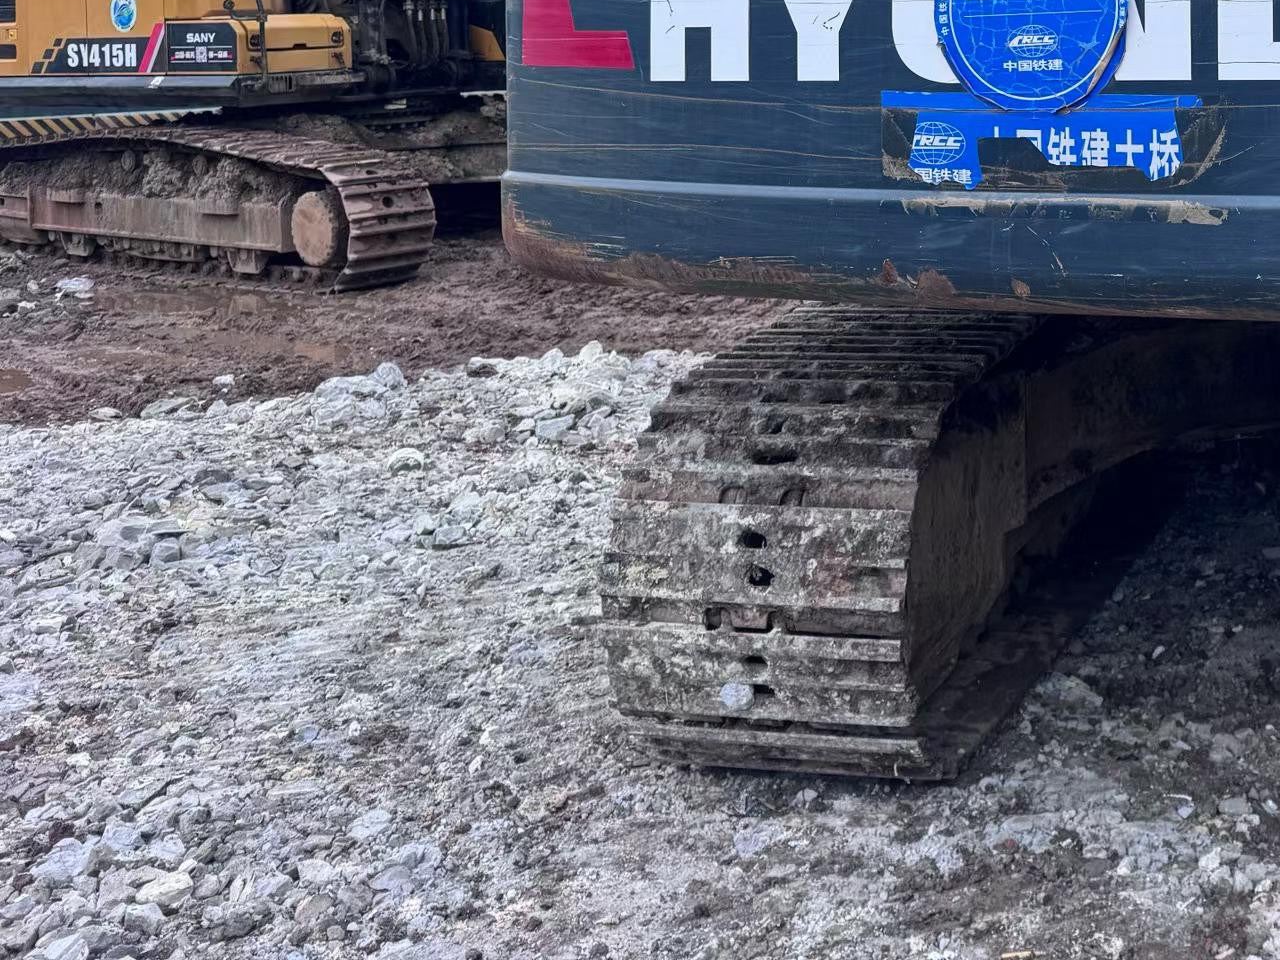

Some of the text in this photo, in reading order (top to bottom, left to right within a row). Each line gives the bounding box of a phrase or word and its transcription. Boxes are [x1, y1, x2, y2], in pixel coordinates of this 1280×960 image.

[186, 32, 216, 43] SANY
[67, 43, 137, 68] SY415H
[1003, 58, 1063, 73] 中国铁建
[914, 167, 972, 185] 国铁建
